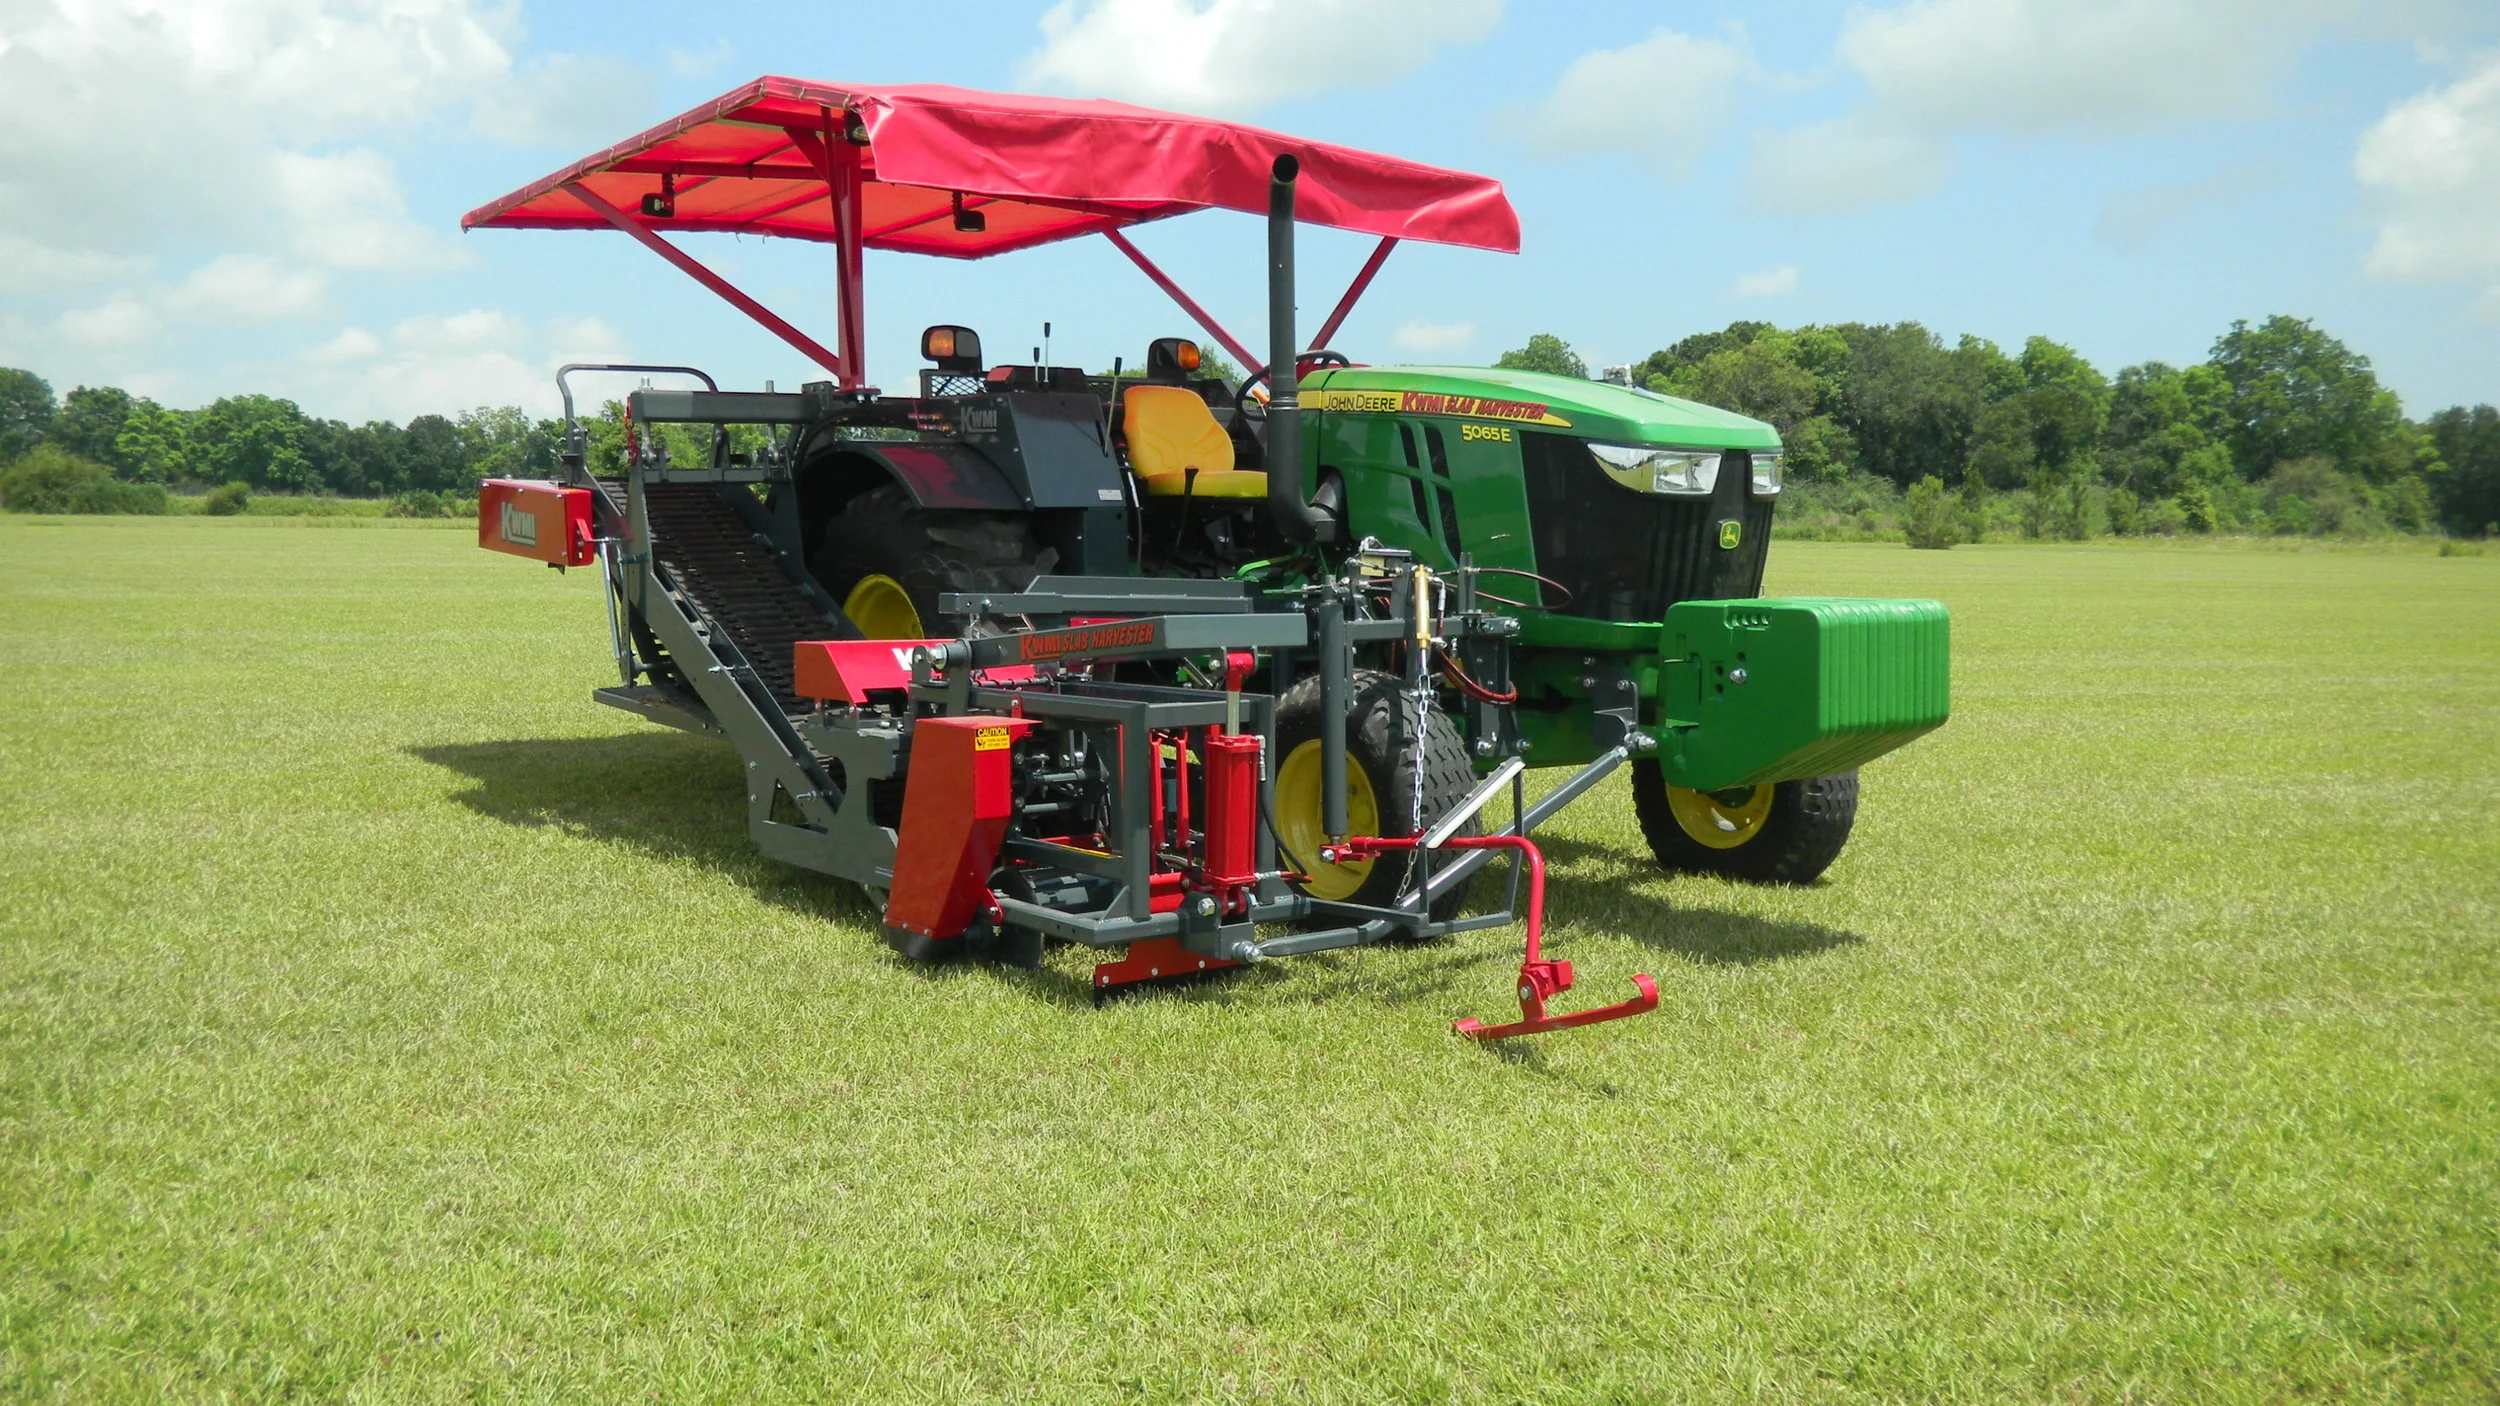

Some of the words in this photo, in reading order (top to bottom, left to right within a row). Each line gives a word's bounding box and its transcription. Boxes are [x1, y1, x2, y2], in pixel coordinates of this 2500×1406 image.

[960, 406, 998, 434] KWMI
[1324, 394, 1355, 411] JOHN
[1356, 394, 1397, 412] DEERE
[1401, 391, 1443, 413] KWMI
[1444, 395, 1476, 415] SLAB
[1475, 398, 1549, 421] HARVESTER
[1461, 424, 1513, 443] 5065E
[501, 501, 537, 545] KWMI
[1020, 633, 1062, 660] KWMI
[1063, 631, 1089, 653] SLAB
[1091, 623, 1155, 649] HARVESTER
[977, 727, 1008, 737] CAUTION
